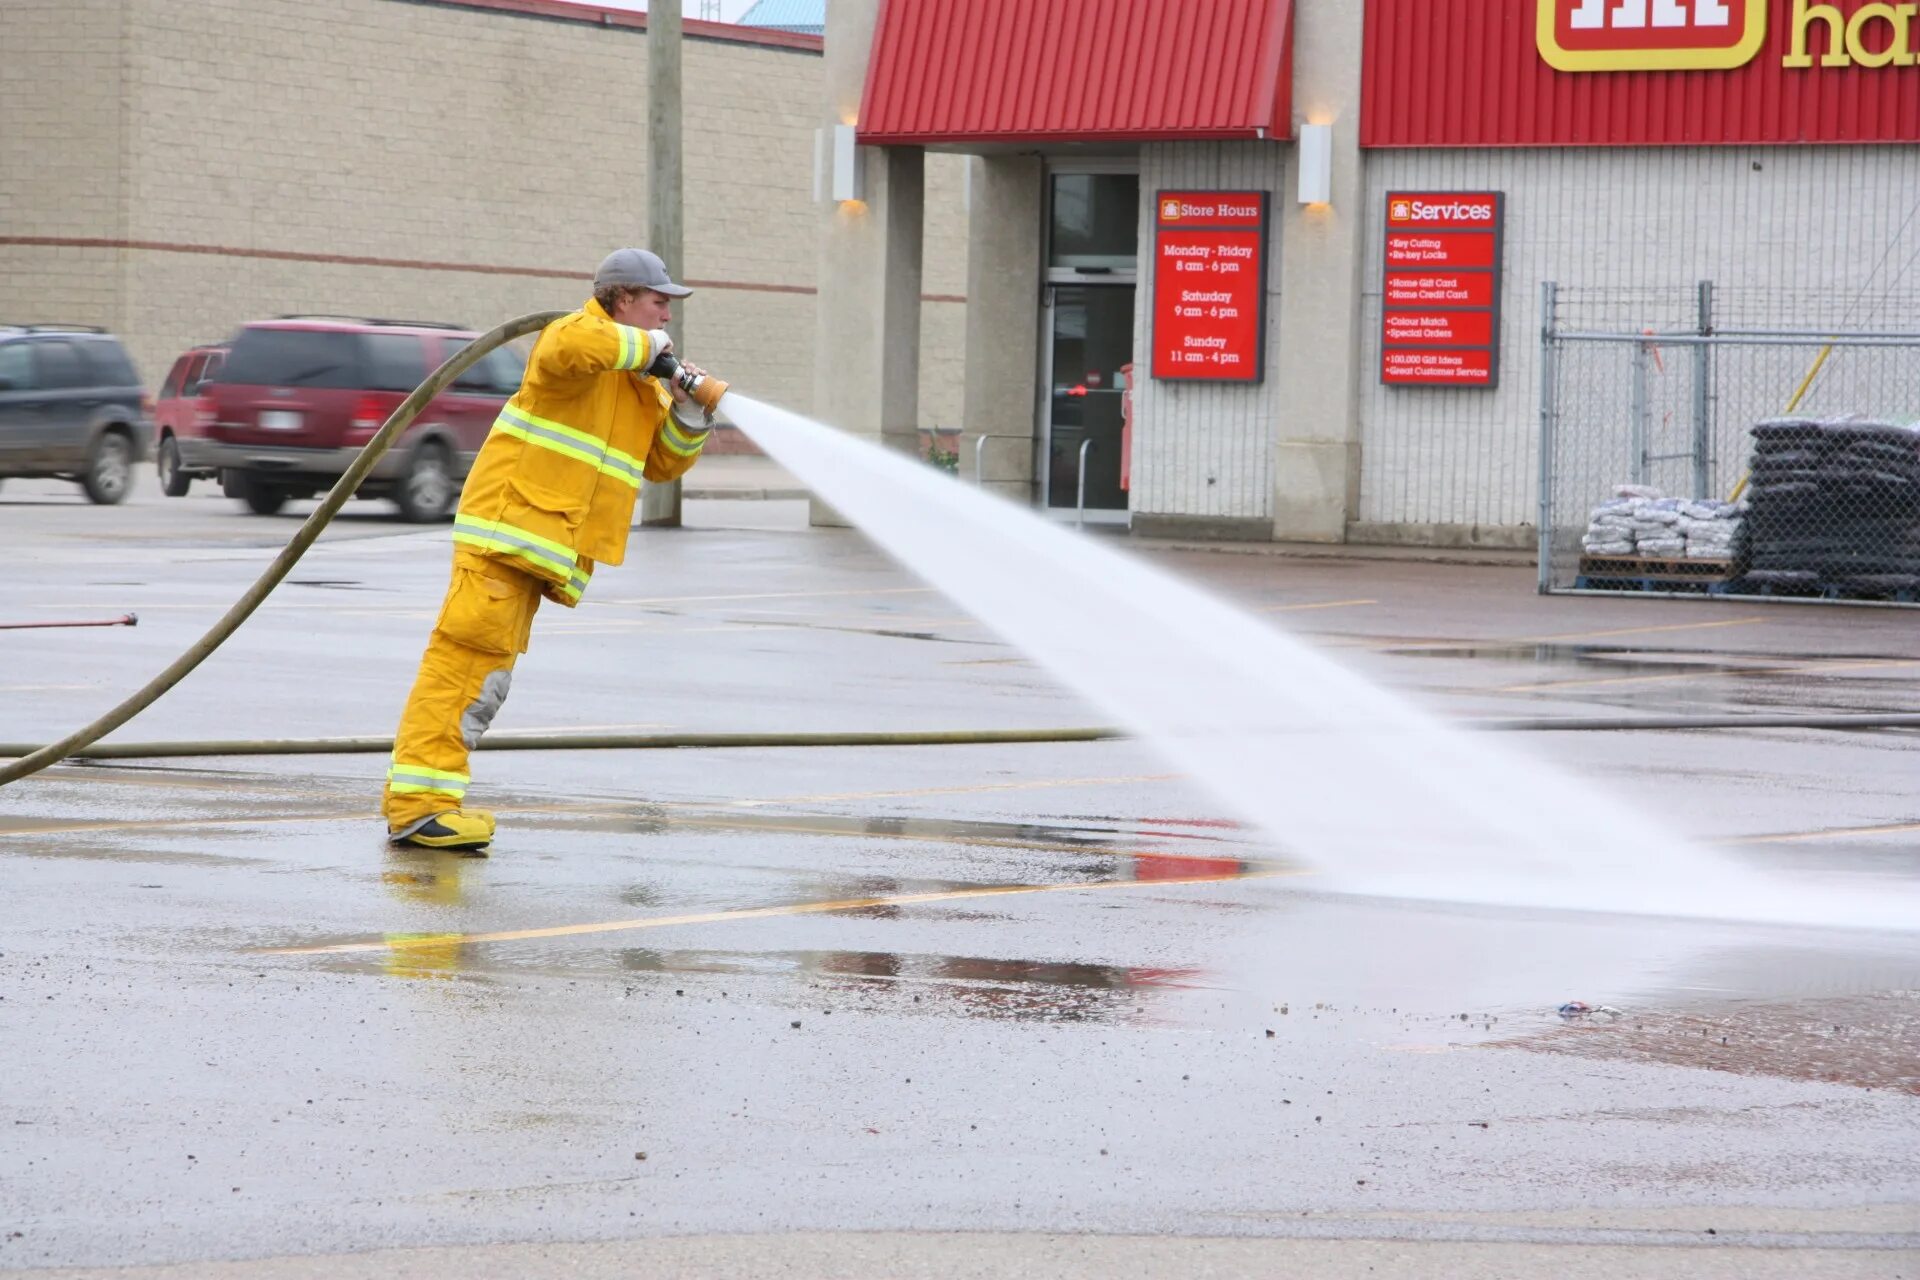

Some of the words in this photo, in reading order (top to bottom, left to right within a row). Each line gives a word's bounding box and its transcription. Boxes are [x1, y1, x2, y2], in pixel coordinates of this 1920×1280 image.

[1782, 0, 1920, 68] ha
[1181, 204, 1214, 216] Store
[1218, 204, 1257, 216] Hours
[1411, 202, 1491, 220] Services
[1164, 245, 1209, 258] Monday
[1218, 245, 1252, 258] Friday
[1176, 260, 1183, 271] 8
[1185, 262, 1204, 271] am
[1211, 261, 1218, 271] 6
[1220, 262, 1239, 273] pm
[1182, 290, 1232, 304] Saturday
[1174, 305, 1182, 316] 9
[1183, 308, 1202, 316] am
[1210, 306, 1217, 317] 6
[1219, 308, 1238, 318] pm
[1184, 336, 1227, 349] Sunday
[1171, 350, 1182, 362] 11
[1184, 353, 1204, 362] am
[1211, 352, 1218, 362] 4
[1220, 353, 1239, 364] pm
